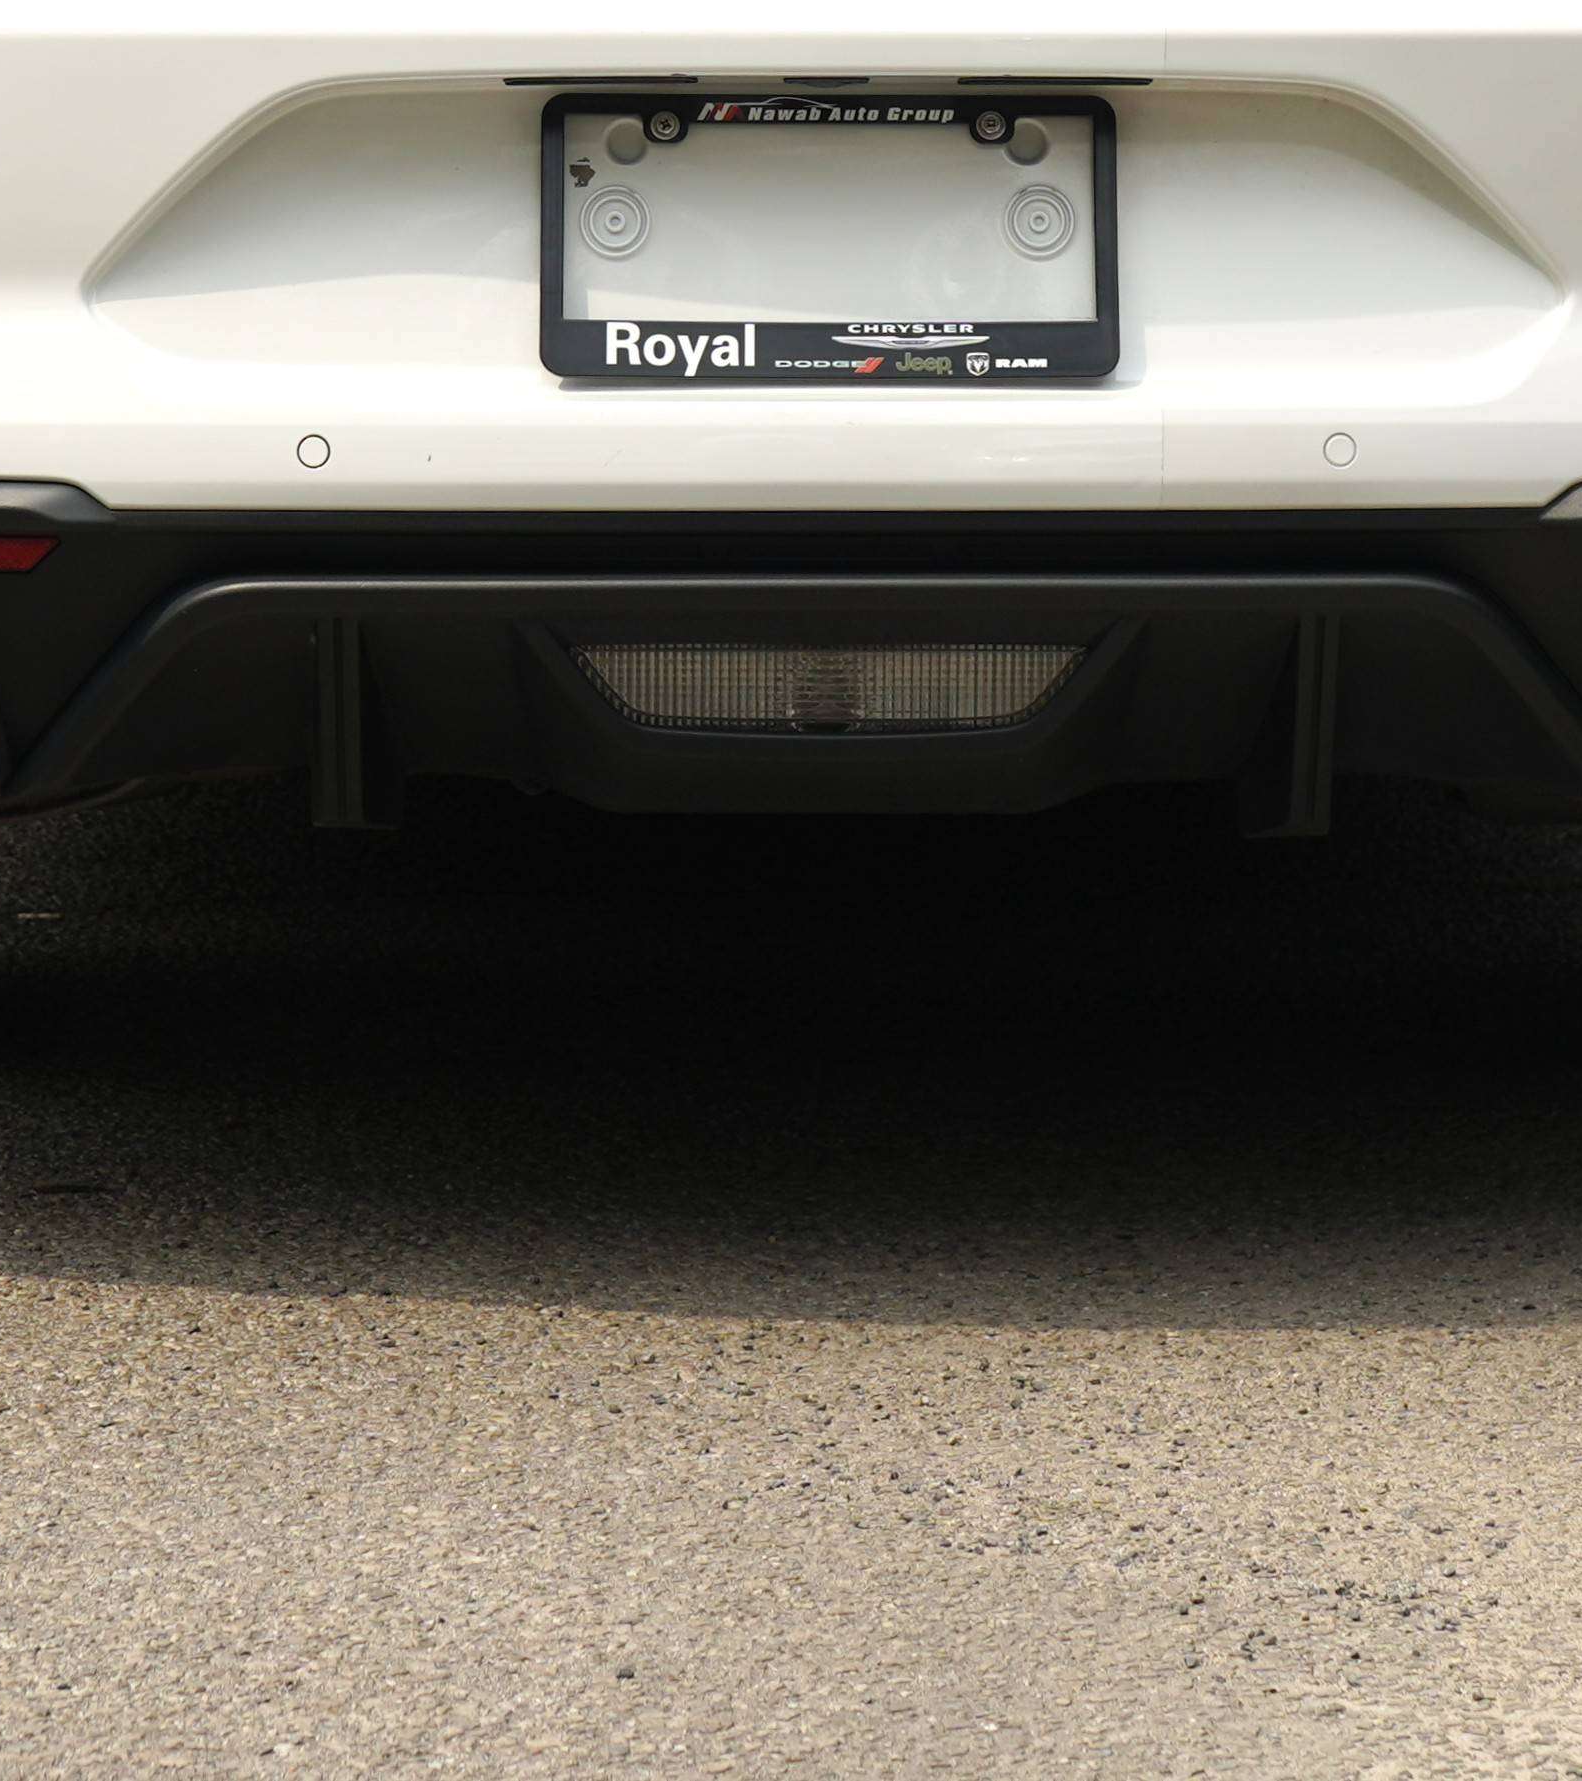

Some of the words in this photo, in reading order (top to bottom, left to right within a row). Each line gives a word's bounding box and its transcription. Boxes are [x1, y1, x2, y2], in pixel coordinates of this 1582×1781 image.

[748, 106, 821, 121] Nawab
[828, 106, 879, 121] Auto
[887, 106, 954, 123] Group
[847, 323, 974, 334] CHRYSLER
[605, 321, 756, 377] Royal
[775, 360, 867, 369] DODGE
[895, 352, 953, 375] Jeep
[995, 358, 1048, 368] RAM
